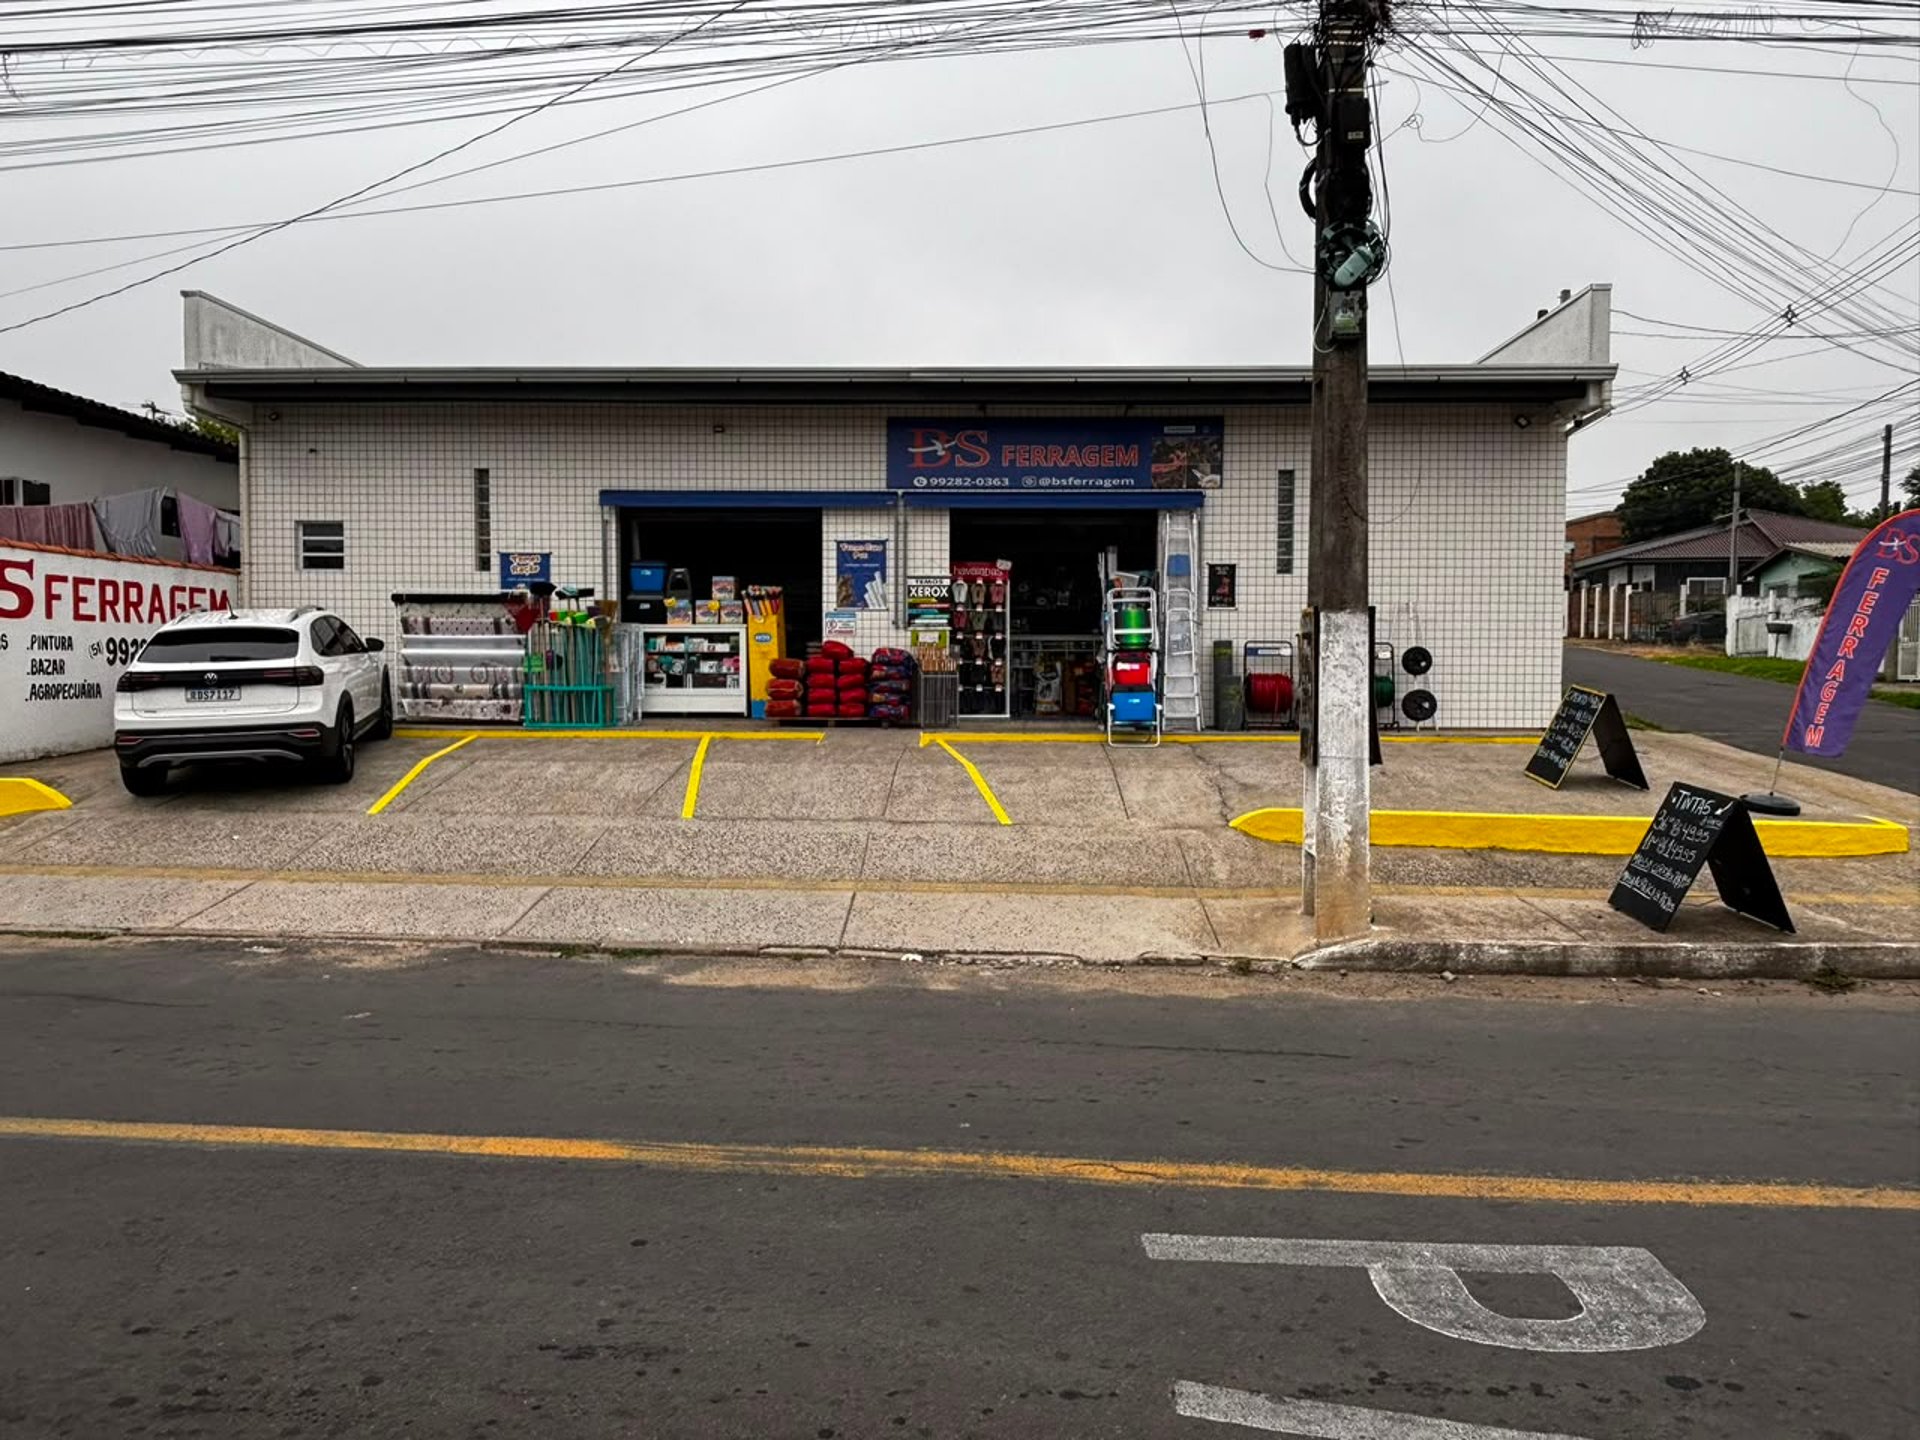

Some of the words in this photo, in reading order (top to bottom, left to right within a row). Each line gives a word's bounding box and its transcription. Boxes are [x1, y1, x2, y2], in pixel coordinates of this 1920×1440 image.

[1002, 445, 1139, 467] FERRAGEM
[929, 477, 1009, 487] 99282-0363
[1039, 476, 1135, 488] @bsferragem
[45, 573, 229, 624] FERRAGEM
[909, 586, 949, 598] XEROX
[1805, 567, 1890, 747] FERRAGEM
